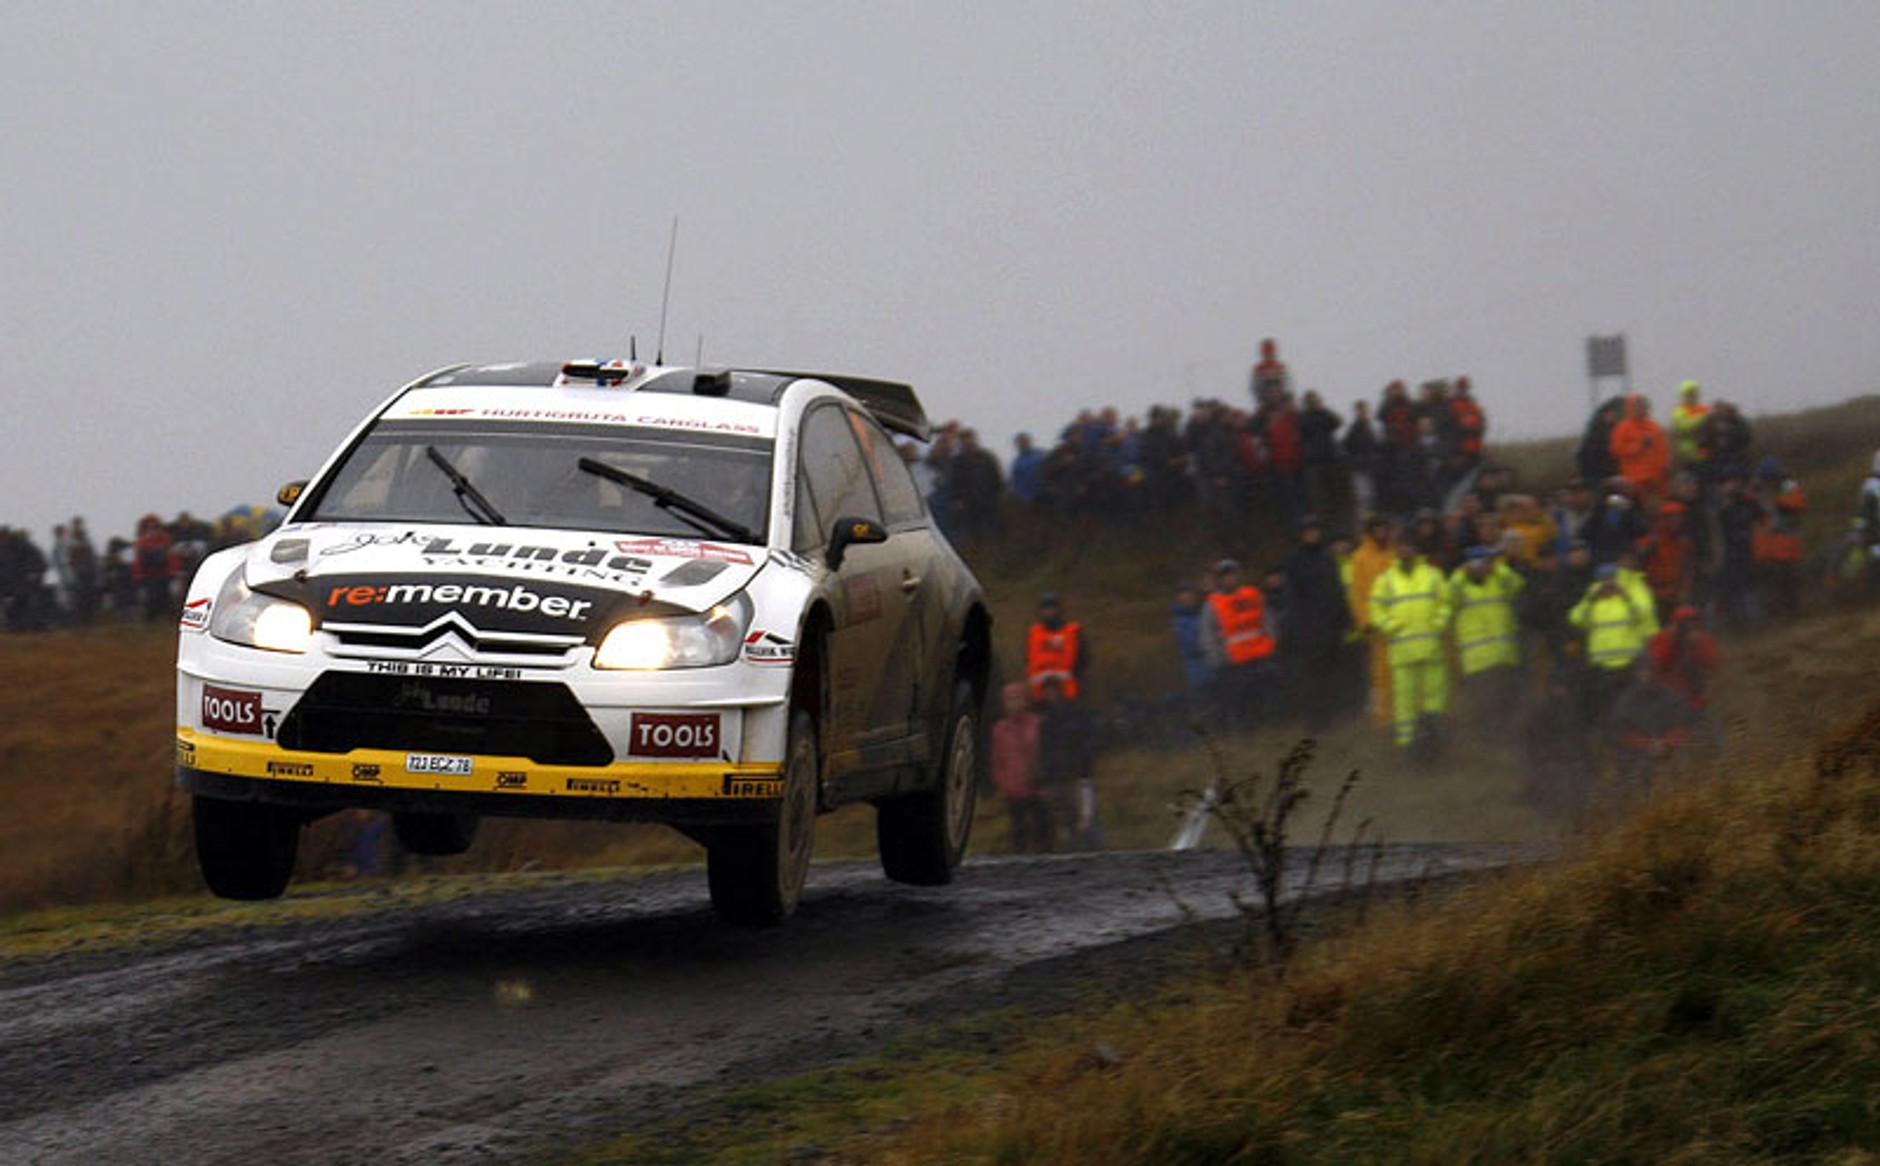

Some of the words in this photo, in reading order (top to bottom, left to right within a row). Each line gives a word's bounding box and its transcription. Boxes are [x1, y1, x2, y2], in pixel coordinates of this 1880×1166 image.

[482, 408, 627, 423] HURTIGRUTA
[637, 415, 760, 434] CARGLASS
[420, 537, 653, 575] Lunde
[423, 556, 645, 587] YACHTING
[367, 661, 409, 675] THIS
[416, 663, 434, 676] IS
[440, 665, 470, 678] MY
[477, 667, 522, 680] LIFE!
[204, 695, 256, 723] TOOLS
[638, 722, 715, 747] TOOLS
